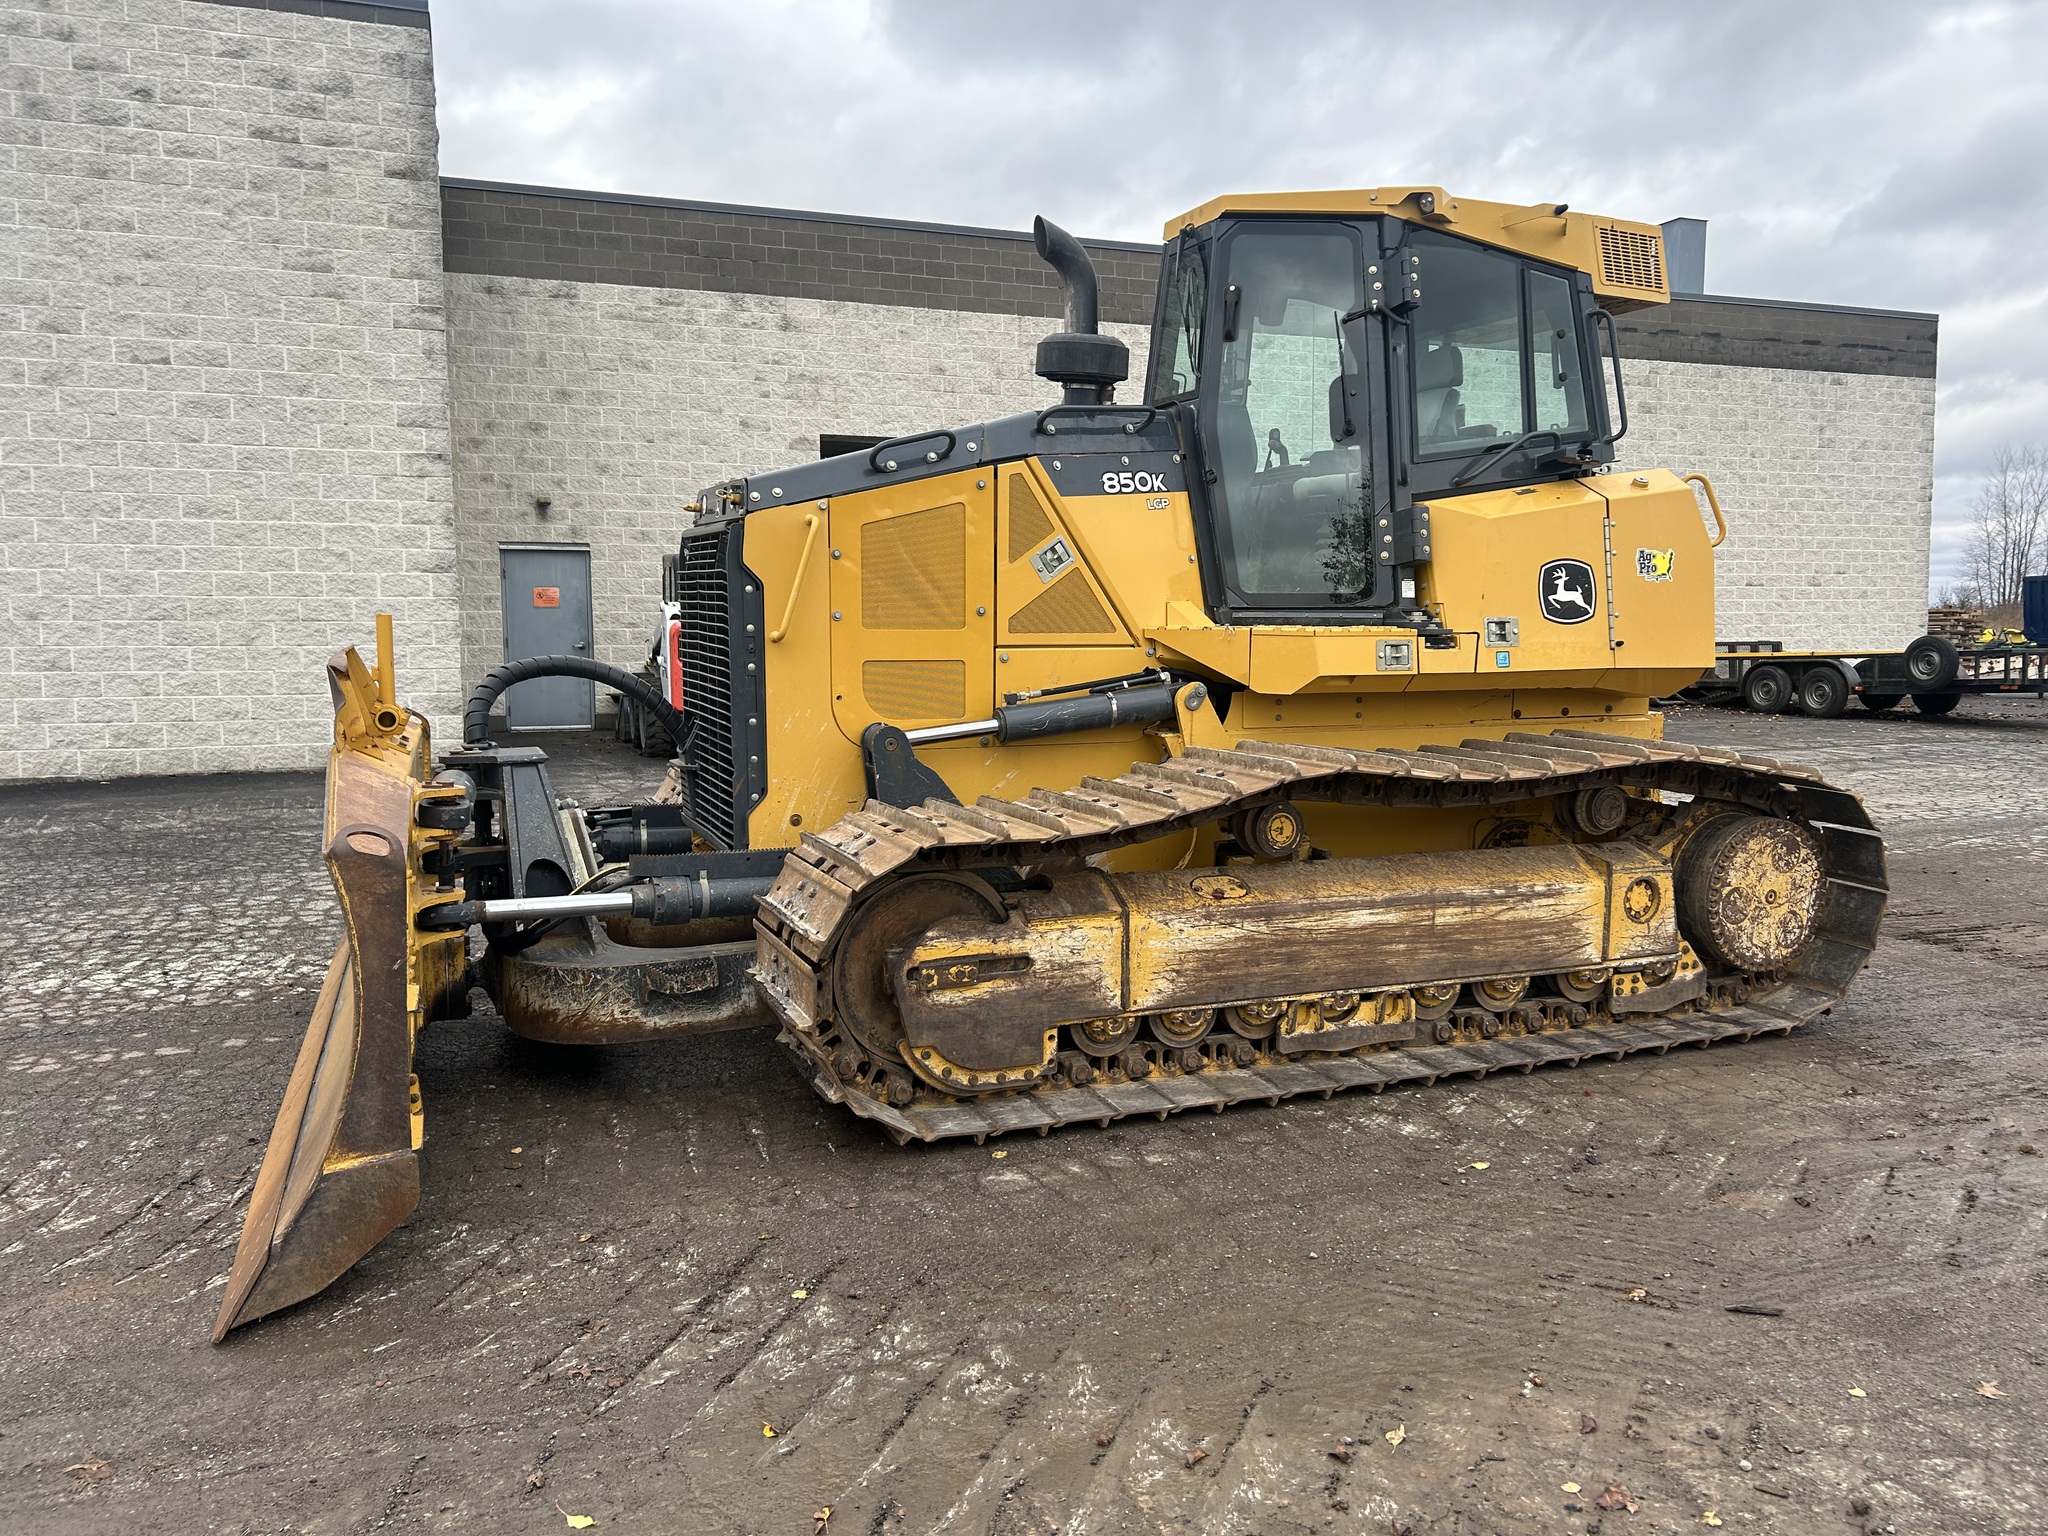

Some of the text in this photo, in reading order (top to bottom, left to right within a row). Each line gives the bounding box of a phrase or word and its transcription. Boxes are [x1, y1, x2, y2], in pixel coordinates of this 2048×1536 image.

[1102, 471, 1168, 494] 850K
[1146, 498, 1170, 510] LGP
[1639, 562, 1657, 573] Pro
